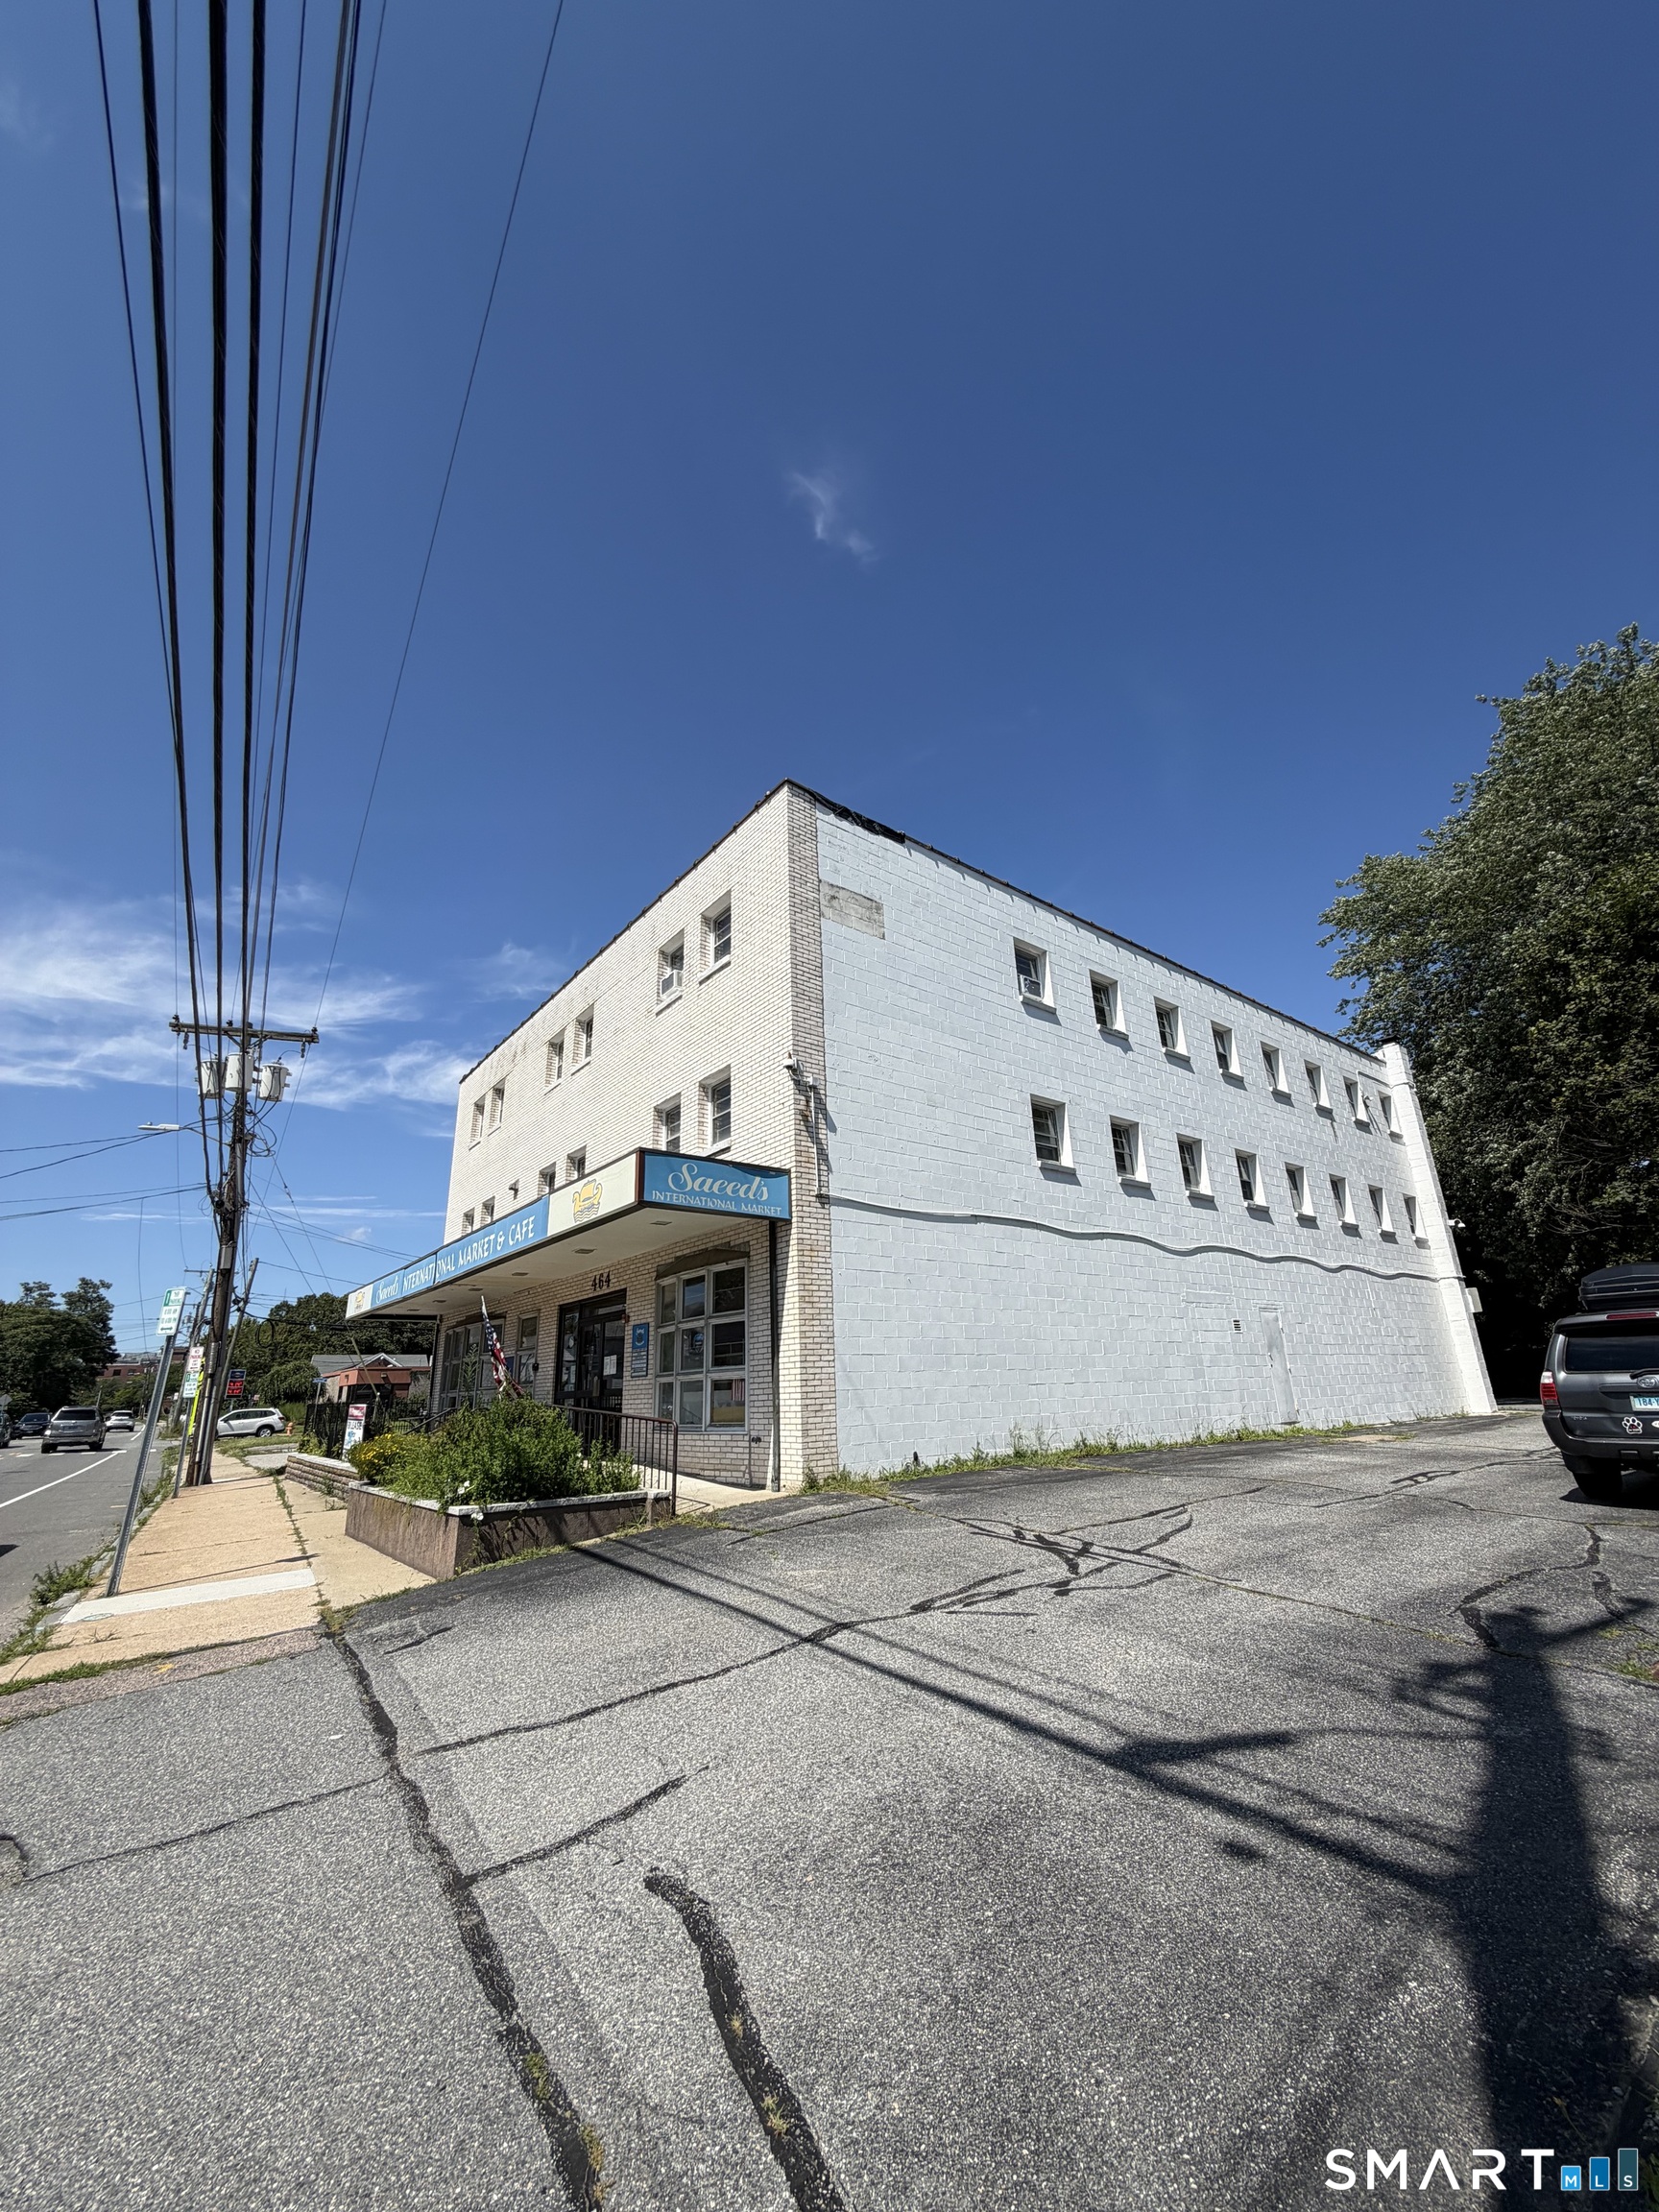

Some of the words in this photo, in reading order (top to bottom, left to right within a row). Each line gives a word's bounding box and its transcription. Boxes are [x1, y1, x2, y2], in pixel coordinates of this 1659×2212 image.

[668, 1163, 769, 1201] Saeed's
[652, 1190, 737, 1211] INTERNATIONAL
[741, 1202, 782, 1215] MARKET
[403, 1253, 456, 1291] NTERNATIONAL
[458, 1233, 496, 1268] MARKET
[496, 1231, 506, 1251] &
[508, 1214, 536, 1246] CAFE
[591, 1270, 611, 1291] 464
